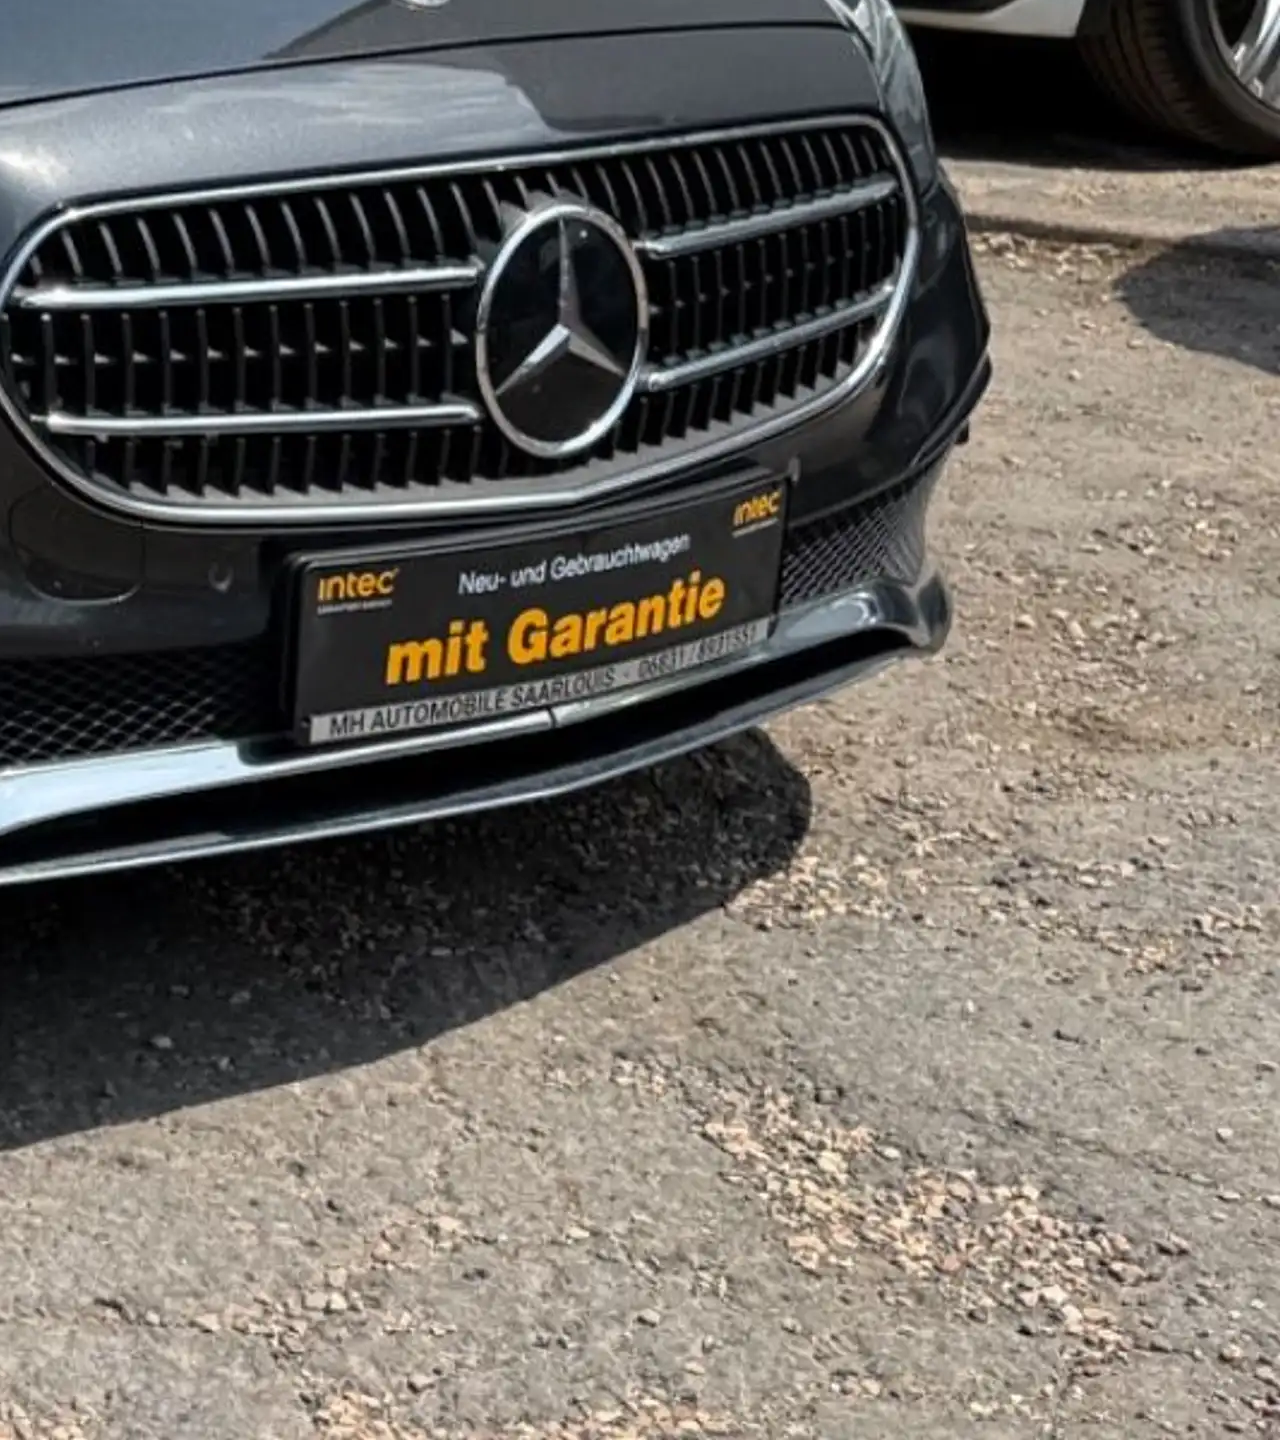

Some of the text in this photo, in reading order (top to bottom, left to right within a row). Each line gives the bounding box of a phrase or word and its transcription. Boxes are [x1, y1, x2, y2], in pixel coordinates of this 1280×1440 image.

[458, 533, 691, 595] Neu- und Gebrauchtwagen
[384, 618, 489, 686] mit
[507, 569, 726, 665] Garantie
[329, 714, 365, 737] MH
[369, 692, 508, 730] AUTOMOBILE
[510, 666, 616, 707] SAARLOUIS
